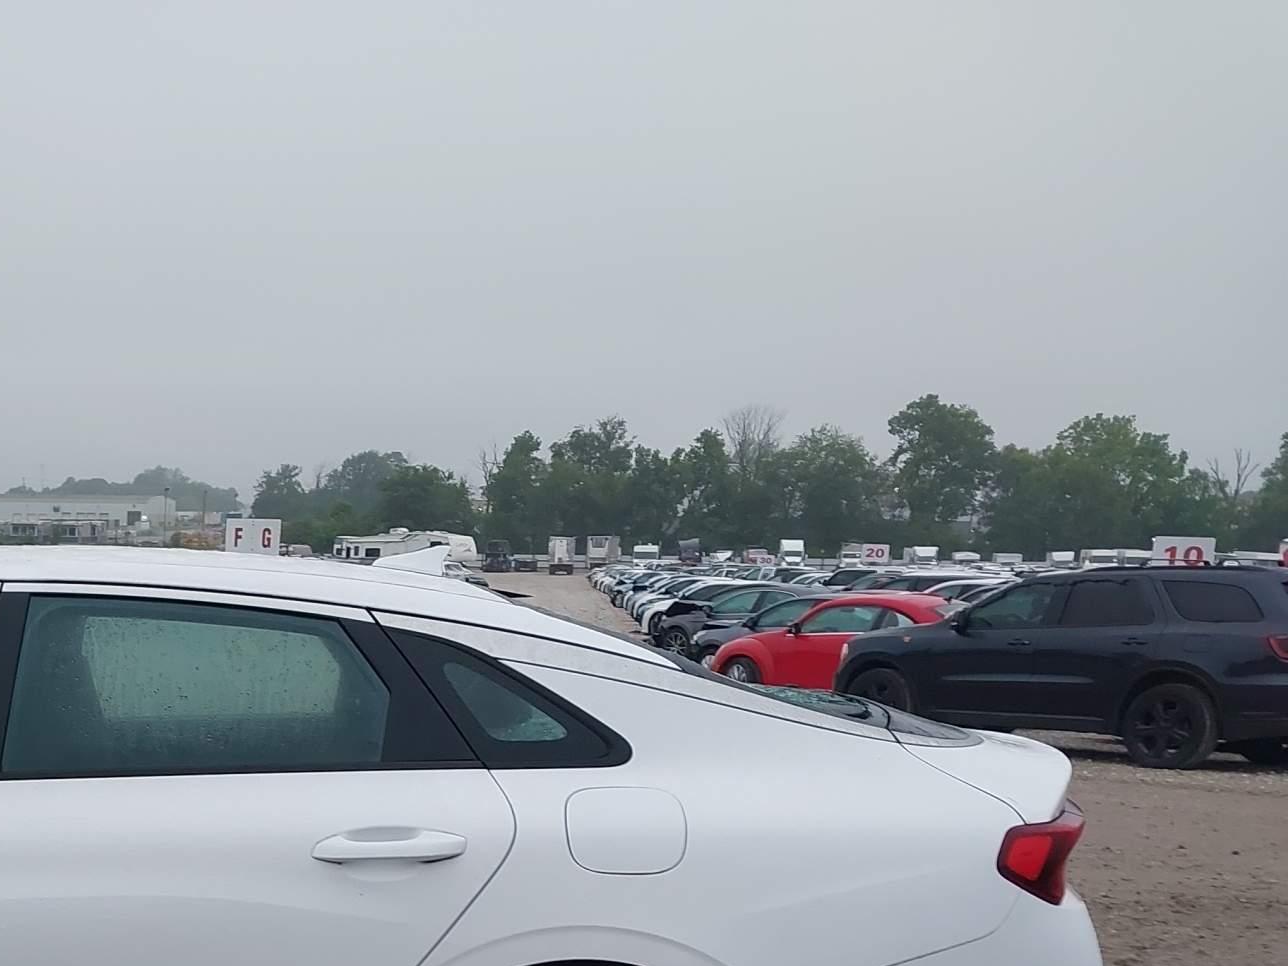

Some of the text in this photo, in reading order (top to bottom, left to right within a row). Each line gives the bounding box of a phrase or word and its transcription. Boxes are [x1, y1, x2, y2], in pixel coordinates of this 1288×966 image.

[234, 527, 272, 548] F G
[865, 548, 885, 559] 20
[1164, 546, 1204, 566] 10
